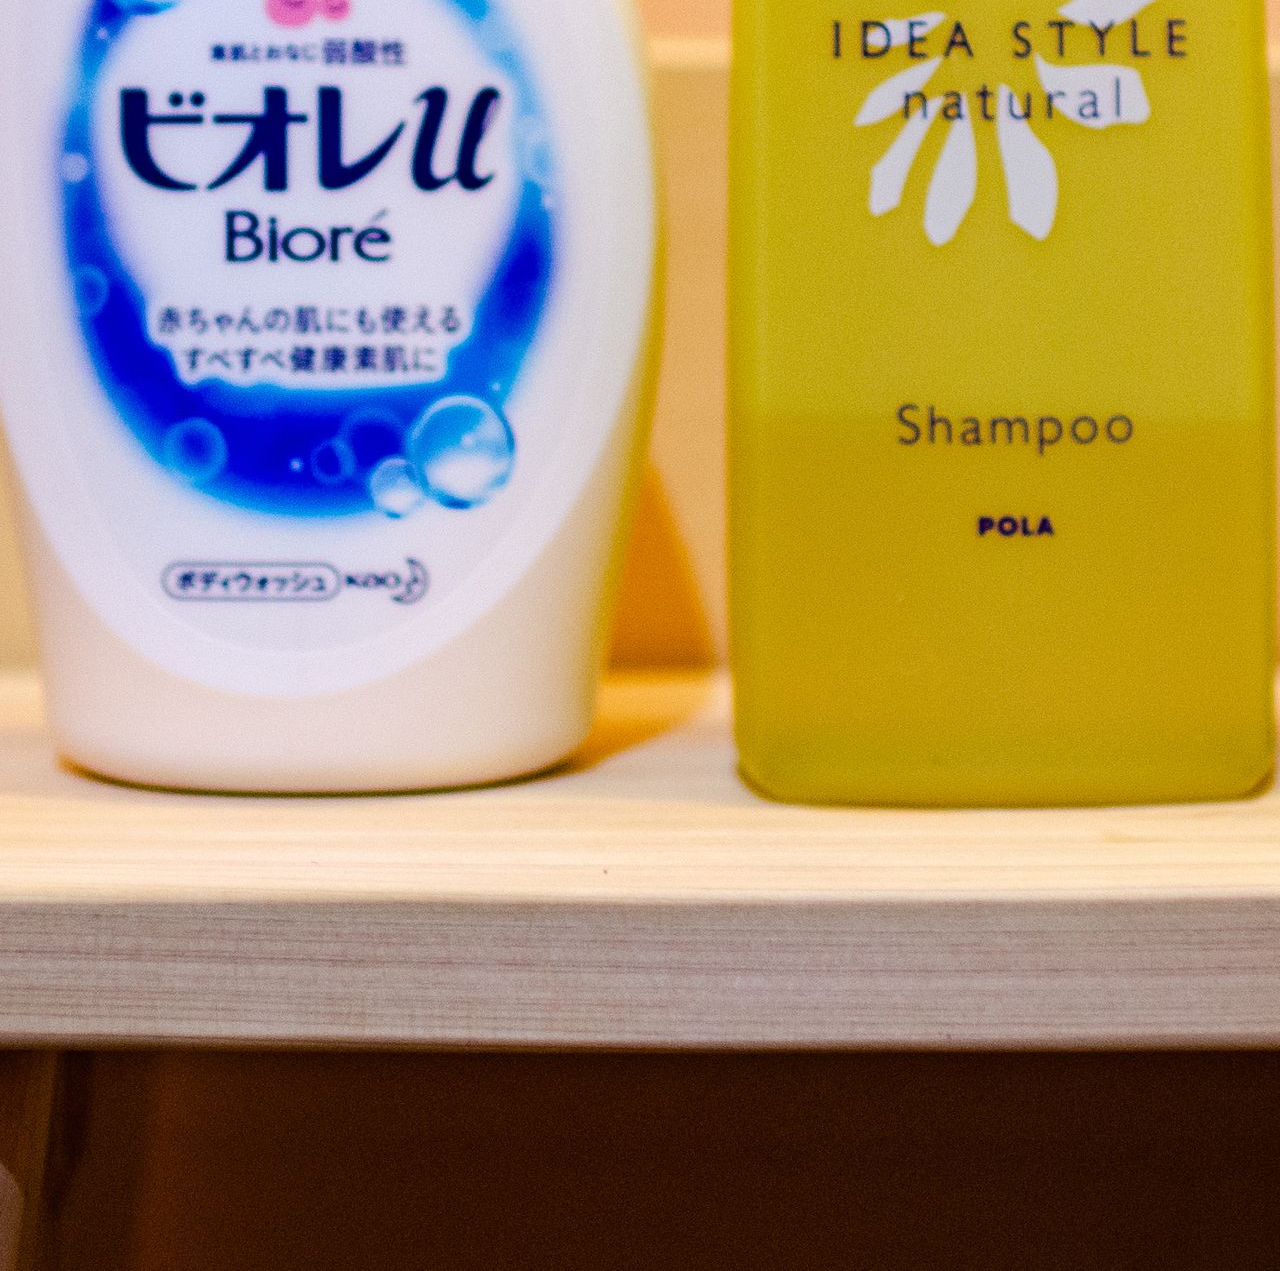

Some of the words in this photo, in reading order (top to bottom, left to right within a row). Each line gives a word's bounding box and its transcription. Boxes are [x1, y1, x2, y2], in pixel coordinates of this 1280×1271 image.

[832, 20, 974, 58] IDEA
[1012, 18, 1187, 57] STYLE
[903, 76, 1122, 121] natural
[225, 209, 392, 263] Bioré
[159, 306, 462, 334] 赤ちゃんの肌にも使える
[184, 344, 437, 373] すべすべ健康素肌に
[896, 403, 1134, 456] Shampoo
[977, 515, 1054, 536] POLA
[177, 570, 326, 592] ボディウォッシュ
